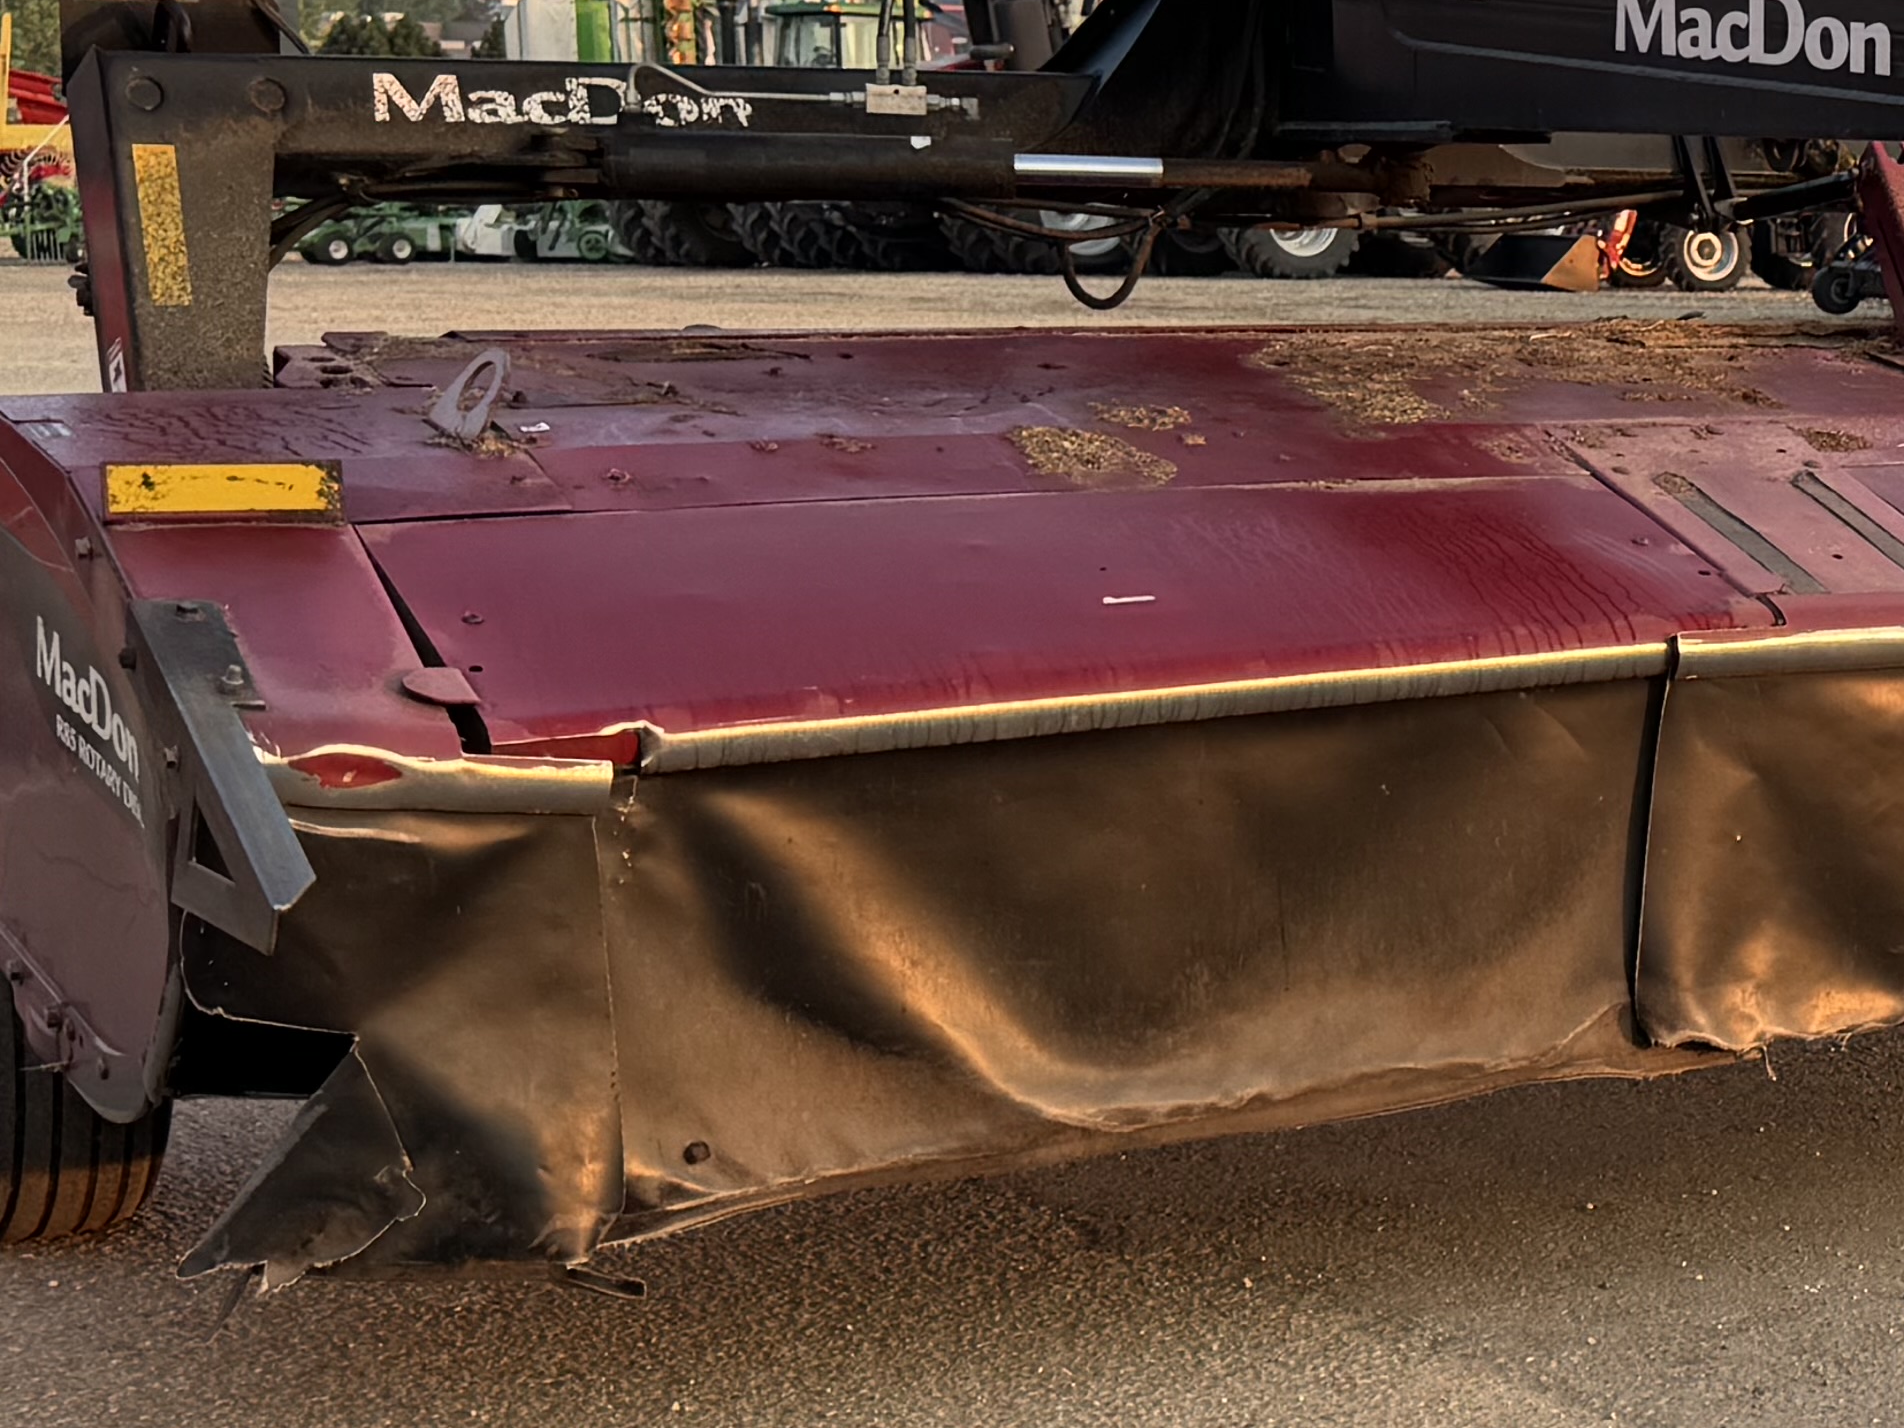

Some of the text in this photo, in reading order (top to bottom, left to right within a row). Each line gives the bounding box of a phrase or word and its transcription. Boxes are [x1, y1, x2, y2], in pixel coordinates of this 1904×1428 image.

[373, 72, 753, 127] MacDon
[36, 615, 139, 784] MacDon
[78, 735, 121, 798] ROTARY
